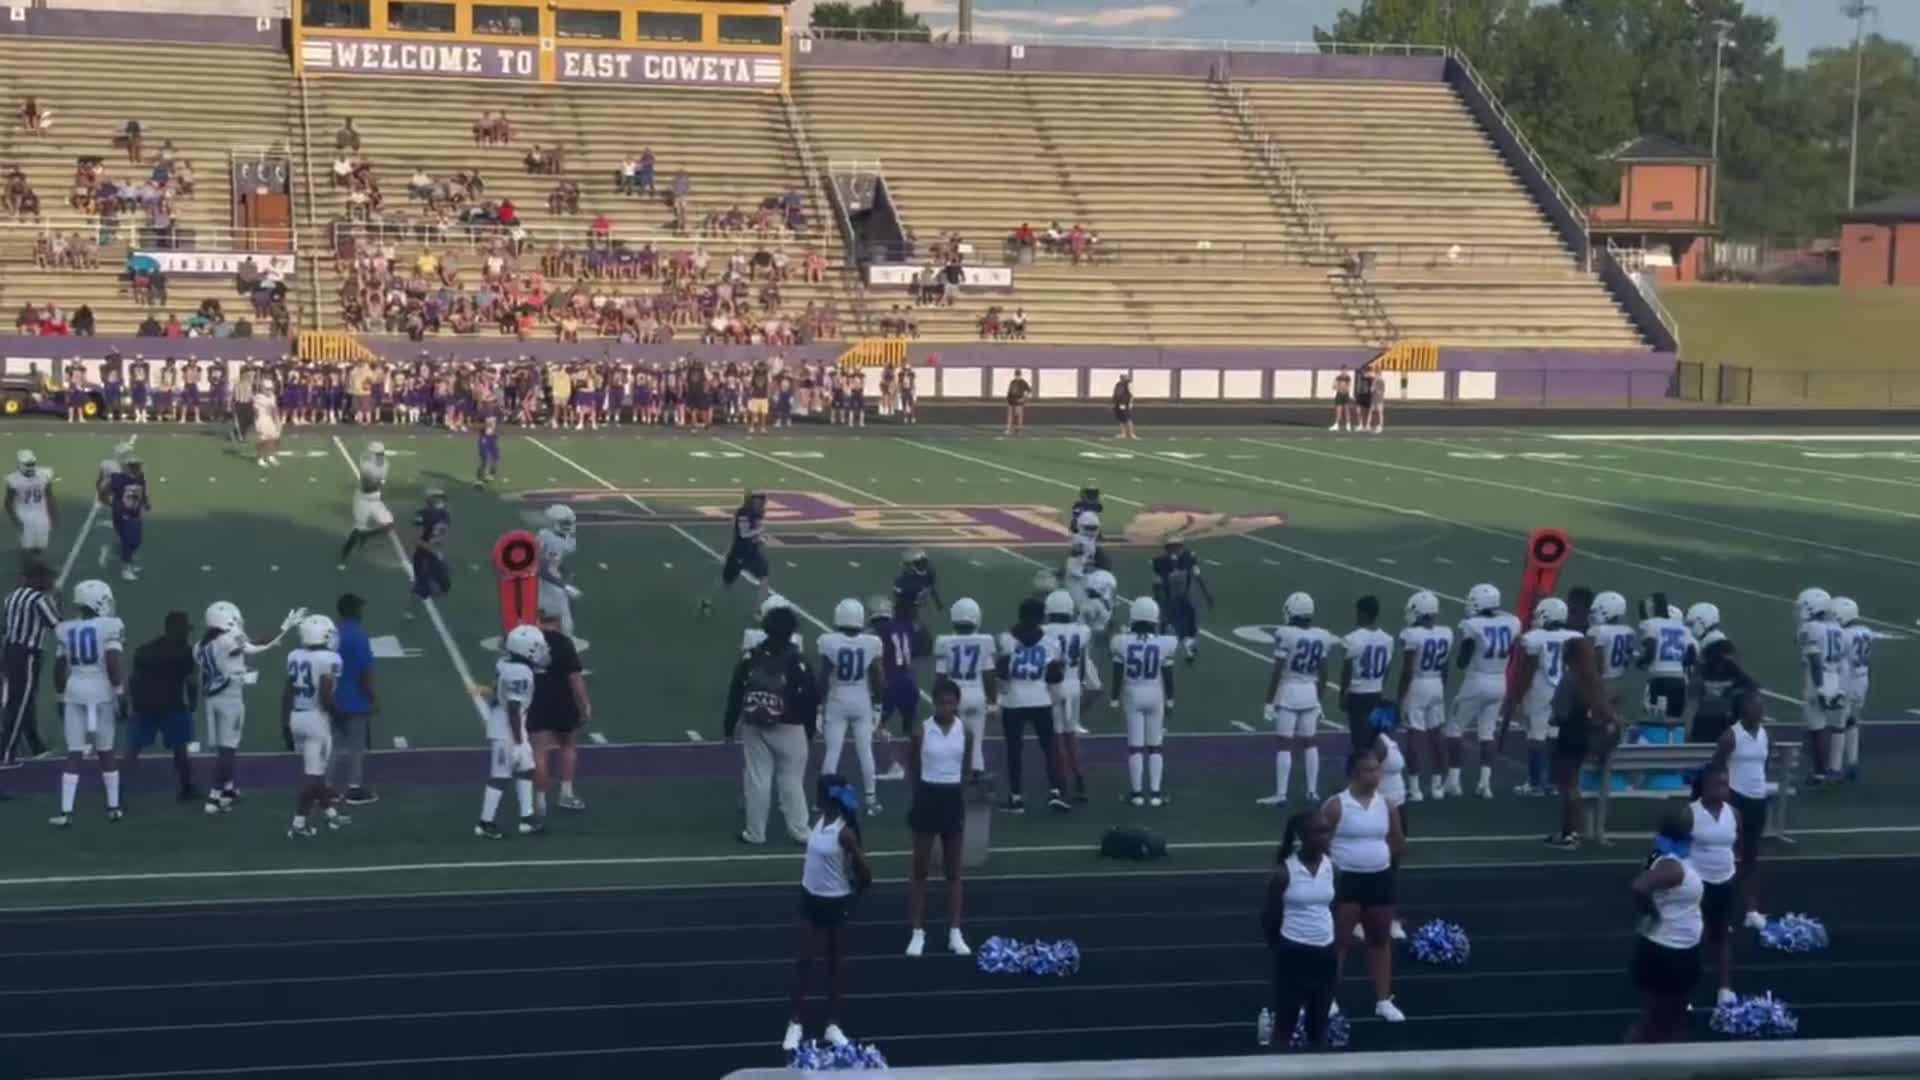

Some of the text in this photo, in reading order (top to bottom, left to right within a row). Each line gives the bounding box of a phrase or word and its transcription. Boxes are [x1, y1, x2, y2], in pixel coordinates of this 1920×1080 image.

[336, 43, 751, 83] WELCOME TO EAST COWETA
[66, 626, 98, 665] 10
[1291, 638, 1324, 674] 28
[1420, 638, 1448, 671] 82
[1483, 625, 1511, 659] 70
[1546, 640, 1562, 677] 7
[289, 659, 315, 698] 23
[836, 647, 865, 681] 81
[951, 643, 981, 680] 17
[1012, 644, 1046, 680] 29
[1126, 643, 1160, 680] 50
[1359, 645, 1388, 680] 40
